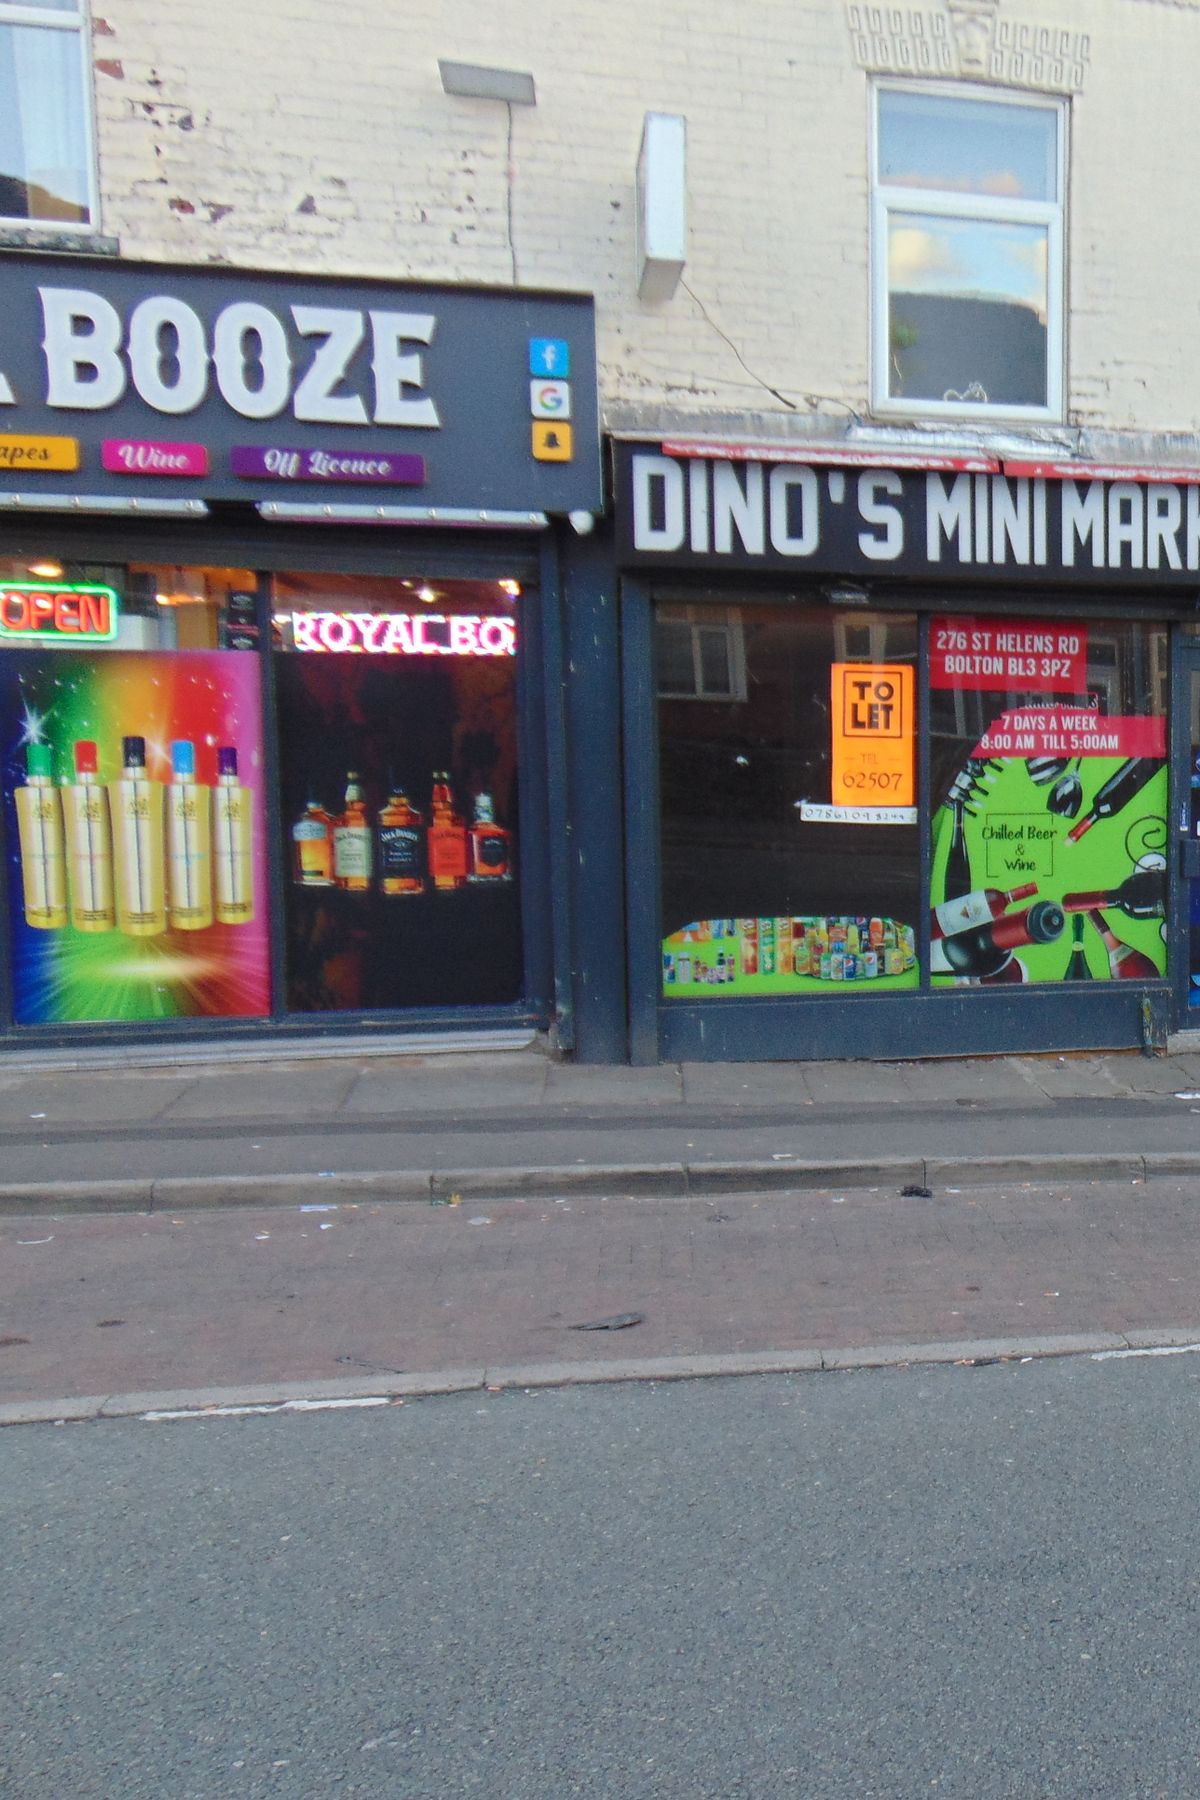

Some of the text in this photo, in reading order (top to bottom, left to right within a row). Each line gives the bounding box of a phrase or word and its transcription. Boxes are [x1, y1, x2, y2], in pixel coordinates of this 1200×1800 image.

[37, 286, 440, 428] BOOZE
[118, 445, 190, 469] Wine
[264, 449, 391, 478] Off Licence
[632, 454, 903, 561] DINO'S
[926, 472, 1046, 565] MINI
[1, 590, 110, 634] OPEN
[292, 612, 446, 653] ROYAL
[936, 630, 1080, 655] 276 ST HELENS RD
[944, 655, 1071, 678] BOLTON BL3 3PZ
[852, 680, 895, 701] TO
[851, 703, 894, 730] LET
[1002, 715, 1097, 731] 7 DAYS A WEEK
[981, 734, 1012, 750] 8:00
[1015, 734, 1035, 750] AM
[1041, 734, 1067, 750] TILL
[842, 772, 903, 791] 62507
[981, 823, 1058, 840] Chilled Beer
[1015, 843, 1025, 856] &
[1004, 858, 1036, 871] Wine
